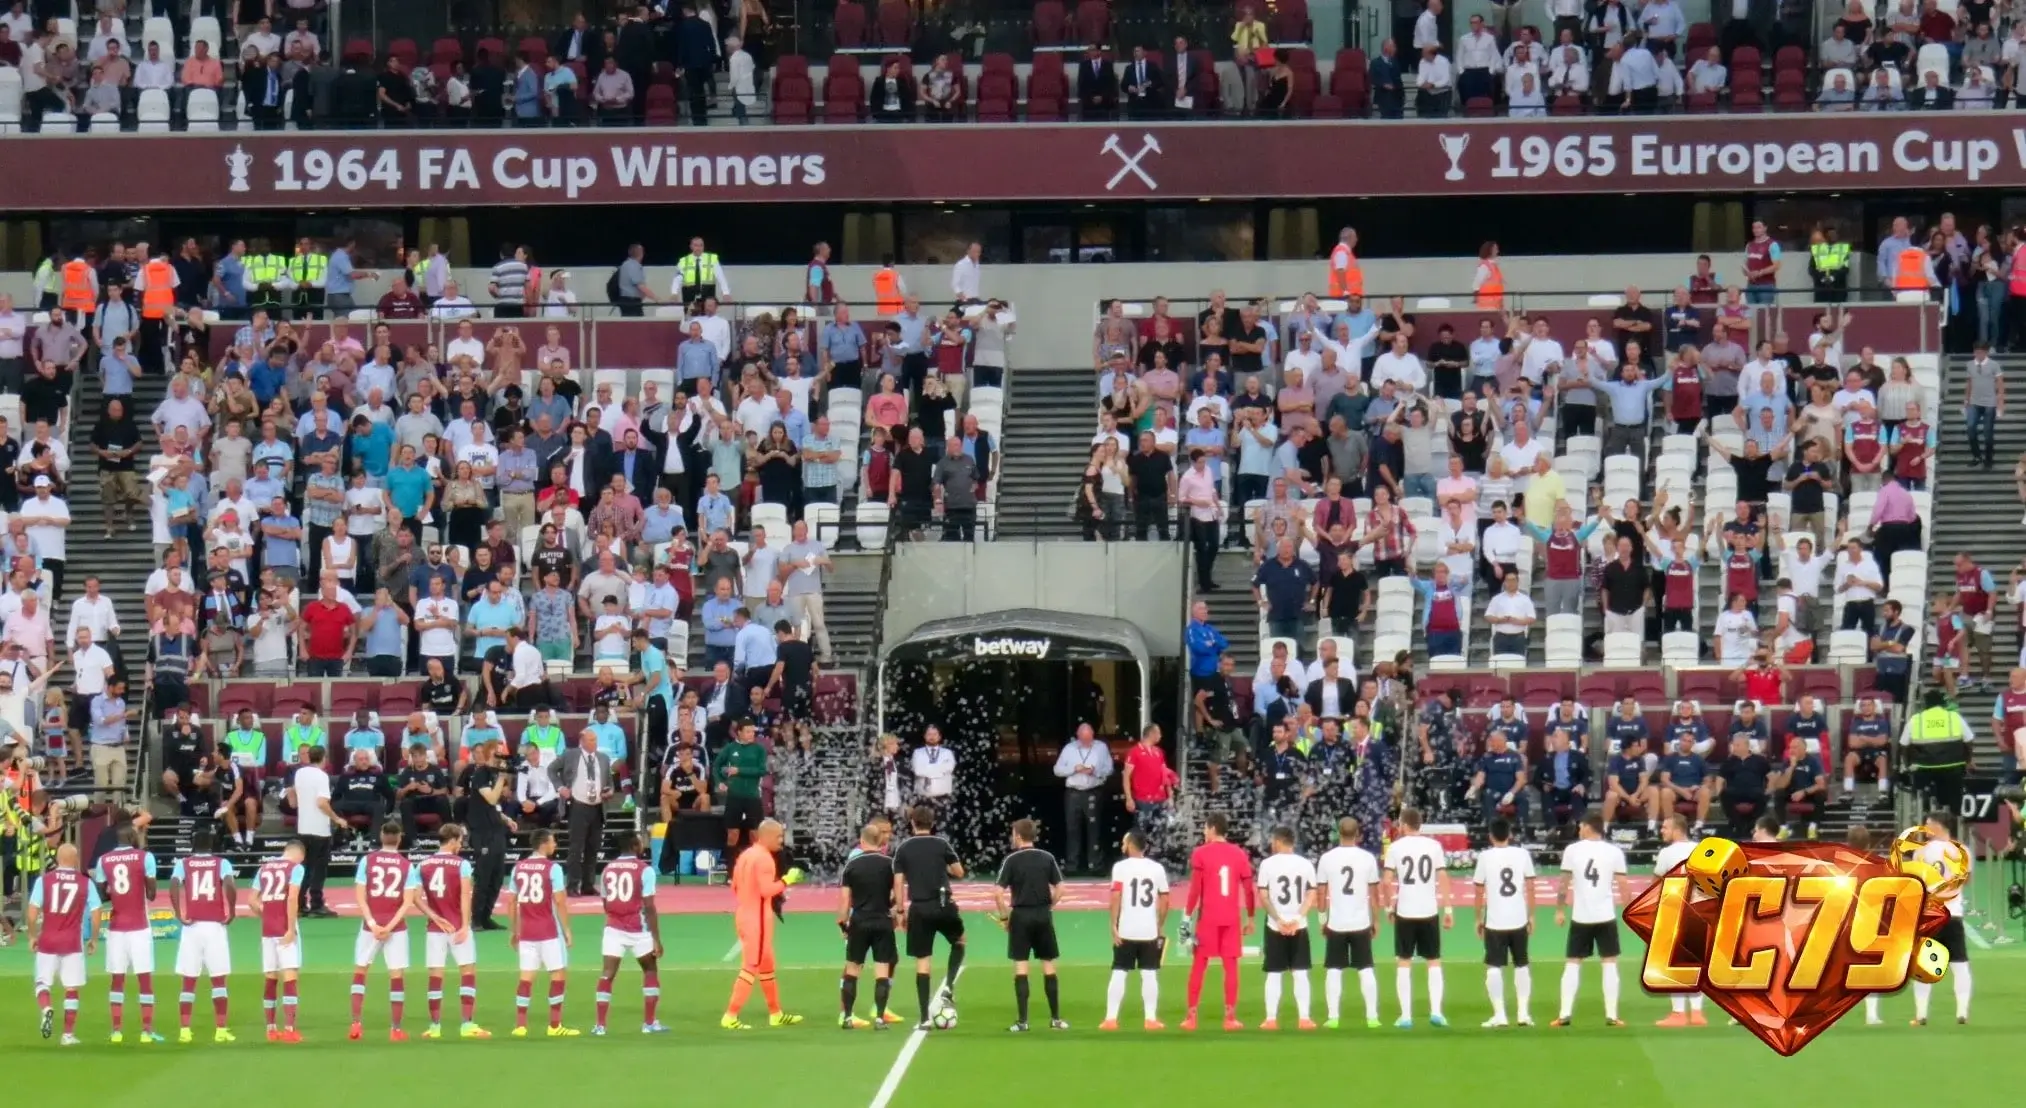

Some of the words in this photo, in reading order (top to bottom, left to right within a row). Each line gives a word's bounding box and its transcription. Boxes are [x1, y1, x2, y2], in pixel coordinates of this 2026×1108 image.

[273, 149, 402, 191] 1964
[418, 149, 480, 190] FA
[493, 147, 598, 198] Cup
[611, 145, 826, 187] Winners
[1490, 134, 1617, 178] 1965
[1631, 134, 1879, 184] European
[1893, 129, 2000, 181] Cup
[974, 636, 1051, 659] betway
[1960, 794, 1993, 818] 07
[113, 863, 130, 895] 8
[191, 869, 216, 902] 14
[370, 865, 402, 898] 32
[428, 866, 447, 898] 4
[1218, 865, 1230, 897] 1
[1341, 865, 1355, 895] 2
[1401, 854, 1433, 885] 20
[1499, 867, 1517, 897] 8
[1584, 858, 1600, 887] 4
[50, 882, 79, 914] 17
[261, 870, 286, 902] 22
[516, 871, 545, 904] 28
[605, 871, 634, 903] 30
[1129, 877, 1154, 908] 13
[1277, 875, 1303, 905] 31
